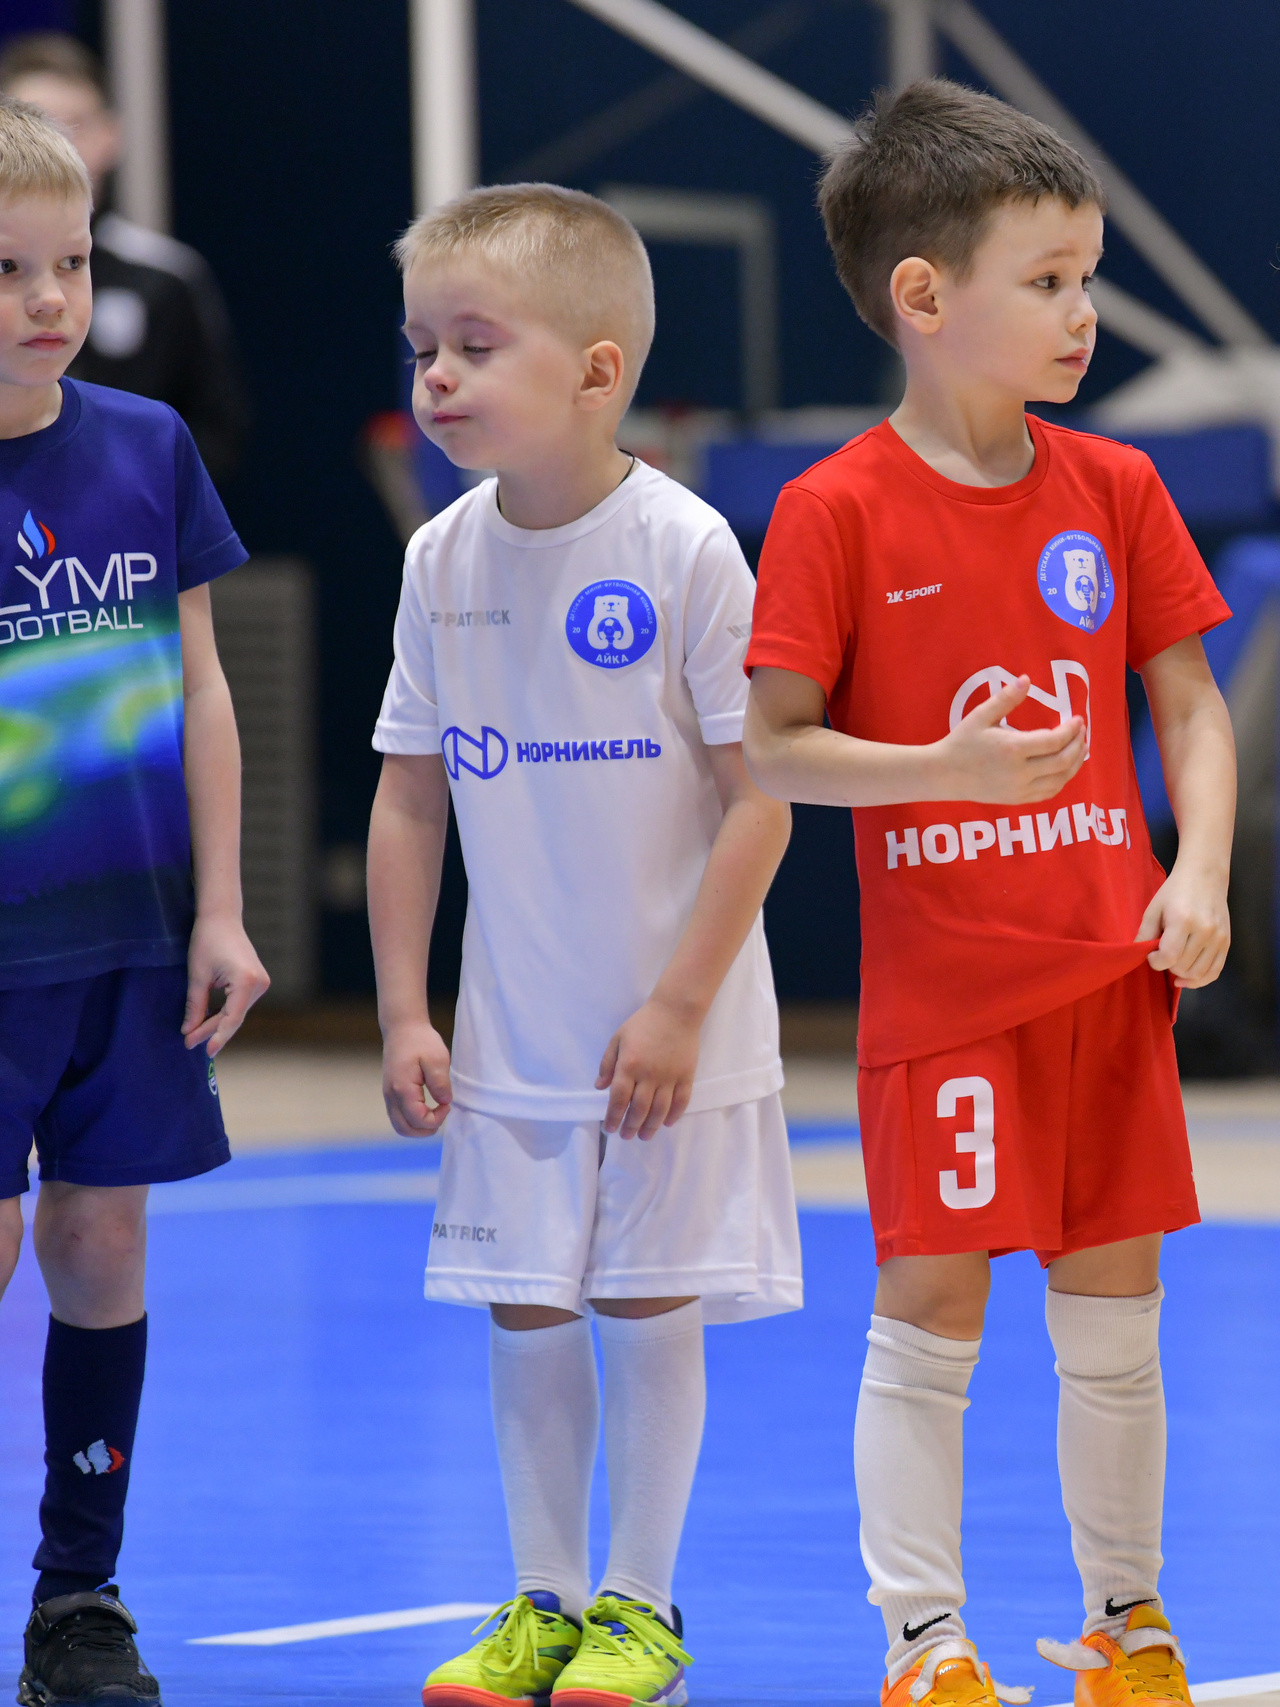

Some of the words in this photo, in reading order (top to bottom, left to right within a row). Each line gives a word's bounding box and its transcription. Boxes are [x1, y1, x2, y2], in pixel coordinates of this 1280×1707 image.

[1040, 551, 1051, 581] ДЕТСКАЯ
[905, 583, 943, 600] SPORT
[595, 652, 630, 665] АЙКА
[516, 738, 662, 764] НОРНИКЕЛЬ
[884, 801, 1132, 871] НОРНИКЕЛ
[936, 1075, 997, 1210] 3
[432, 1222, 498, 1244] PATRICK
